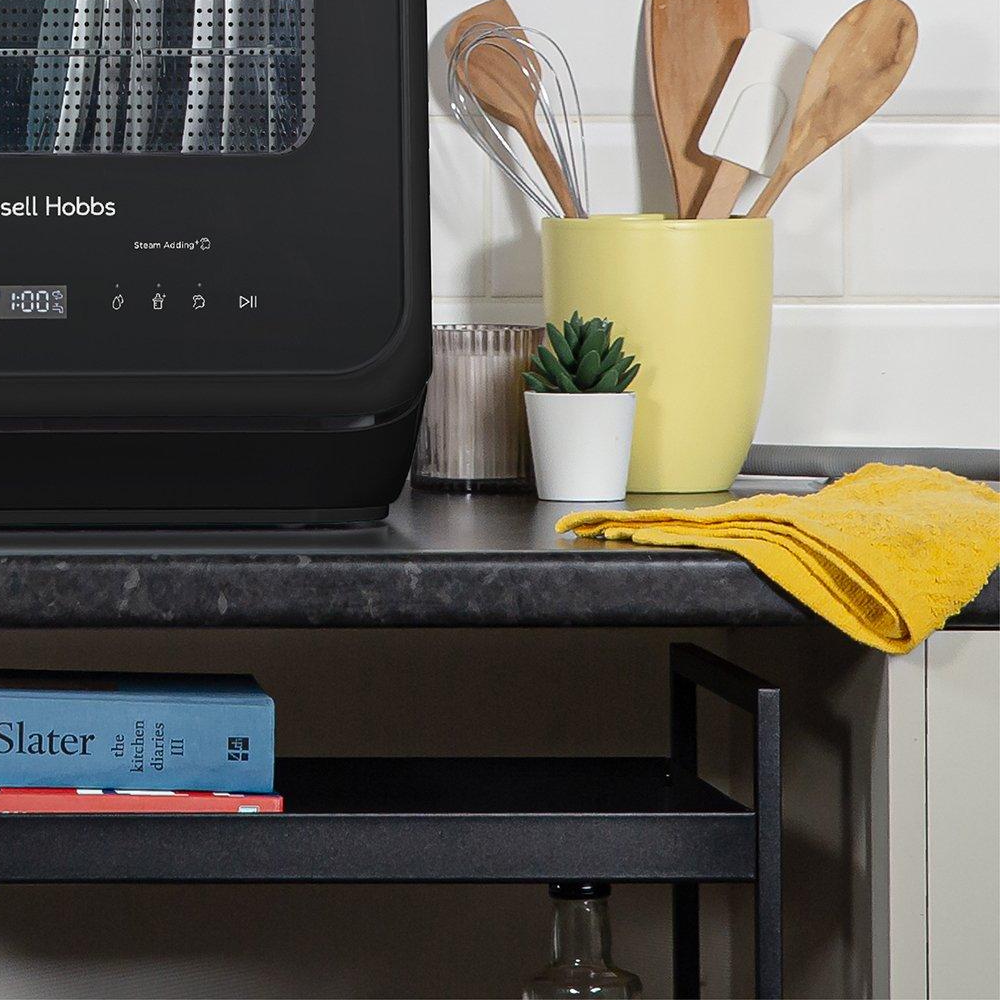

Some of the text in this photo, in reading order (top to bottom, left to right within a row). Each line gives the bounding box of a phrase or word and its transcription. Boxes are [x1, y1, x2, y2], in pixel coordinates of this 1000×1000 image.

[45, 195, 117, 217] Hobbs
[133, 240, 162, 250] Steam
[11, 290, 49, 313] 1:00
[110, 734, 125, 758] the
[129, 720, 145, 773] kitchen
[149, 722, 165, 772] diaries
[170, 738, 184, 757] III
